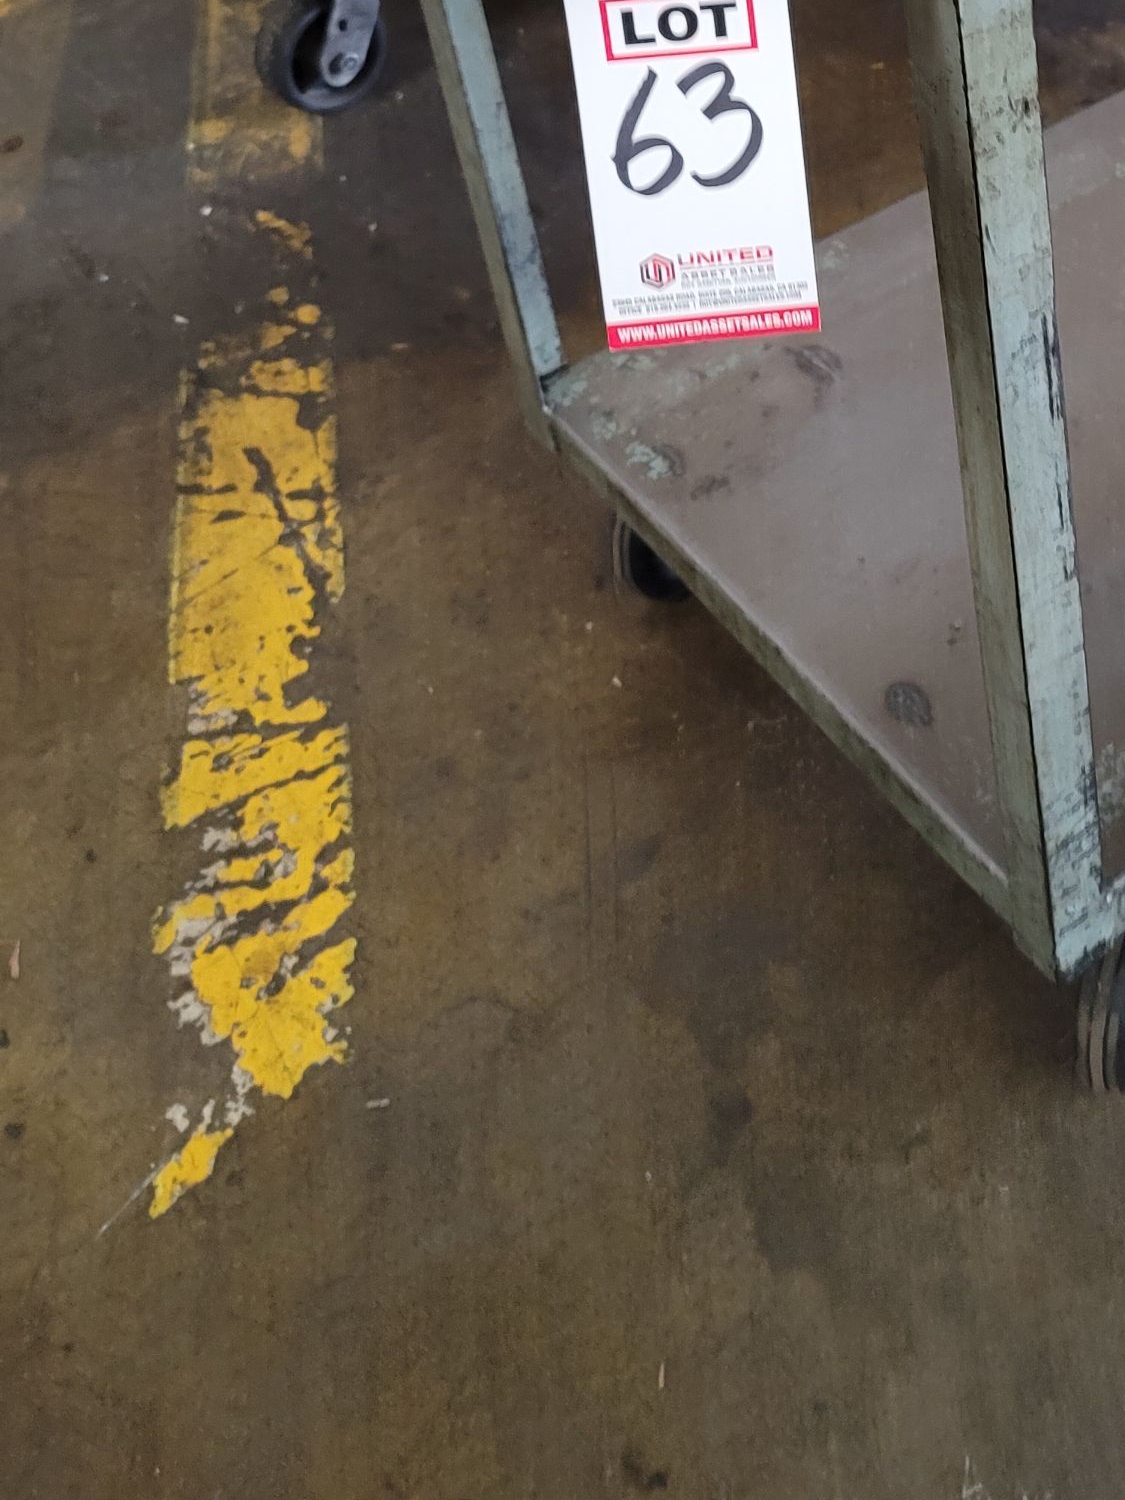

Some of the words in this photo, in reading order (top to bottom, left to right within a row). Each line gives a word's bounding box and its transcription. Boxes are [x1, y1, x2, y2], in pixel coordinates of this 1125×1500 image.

[620, 3, 737, 45] LOT
[611, 61, 763, 195] 63
[677, 245, 774, 265] UNITED
[617, 309, 813, 344] WWW.UNITEDASSETSALES.COM
